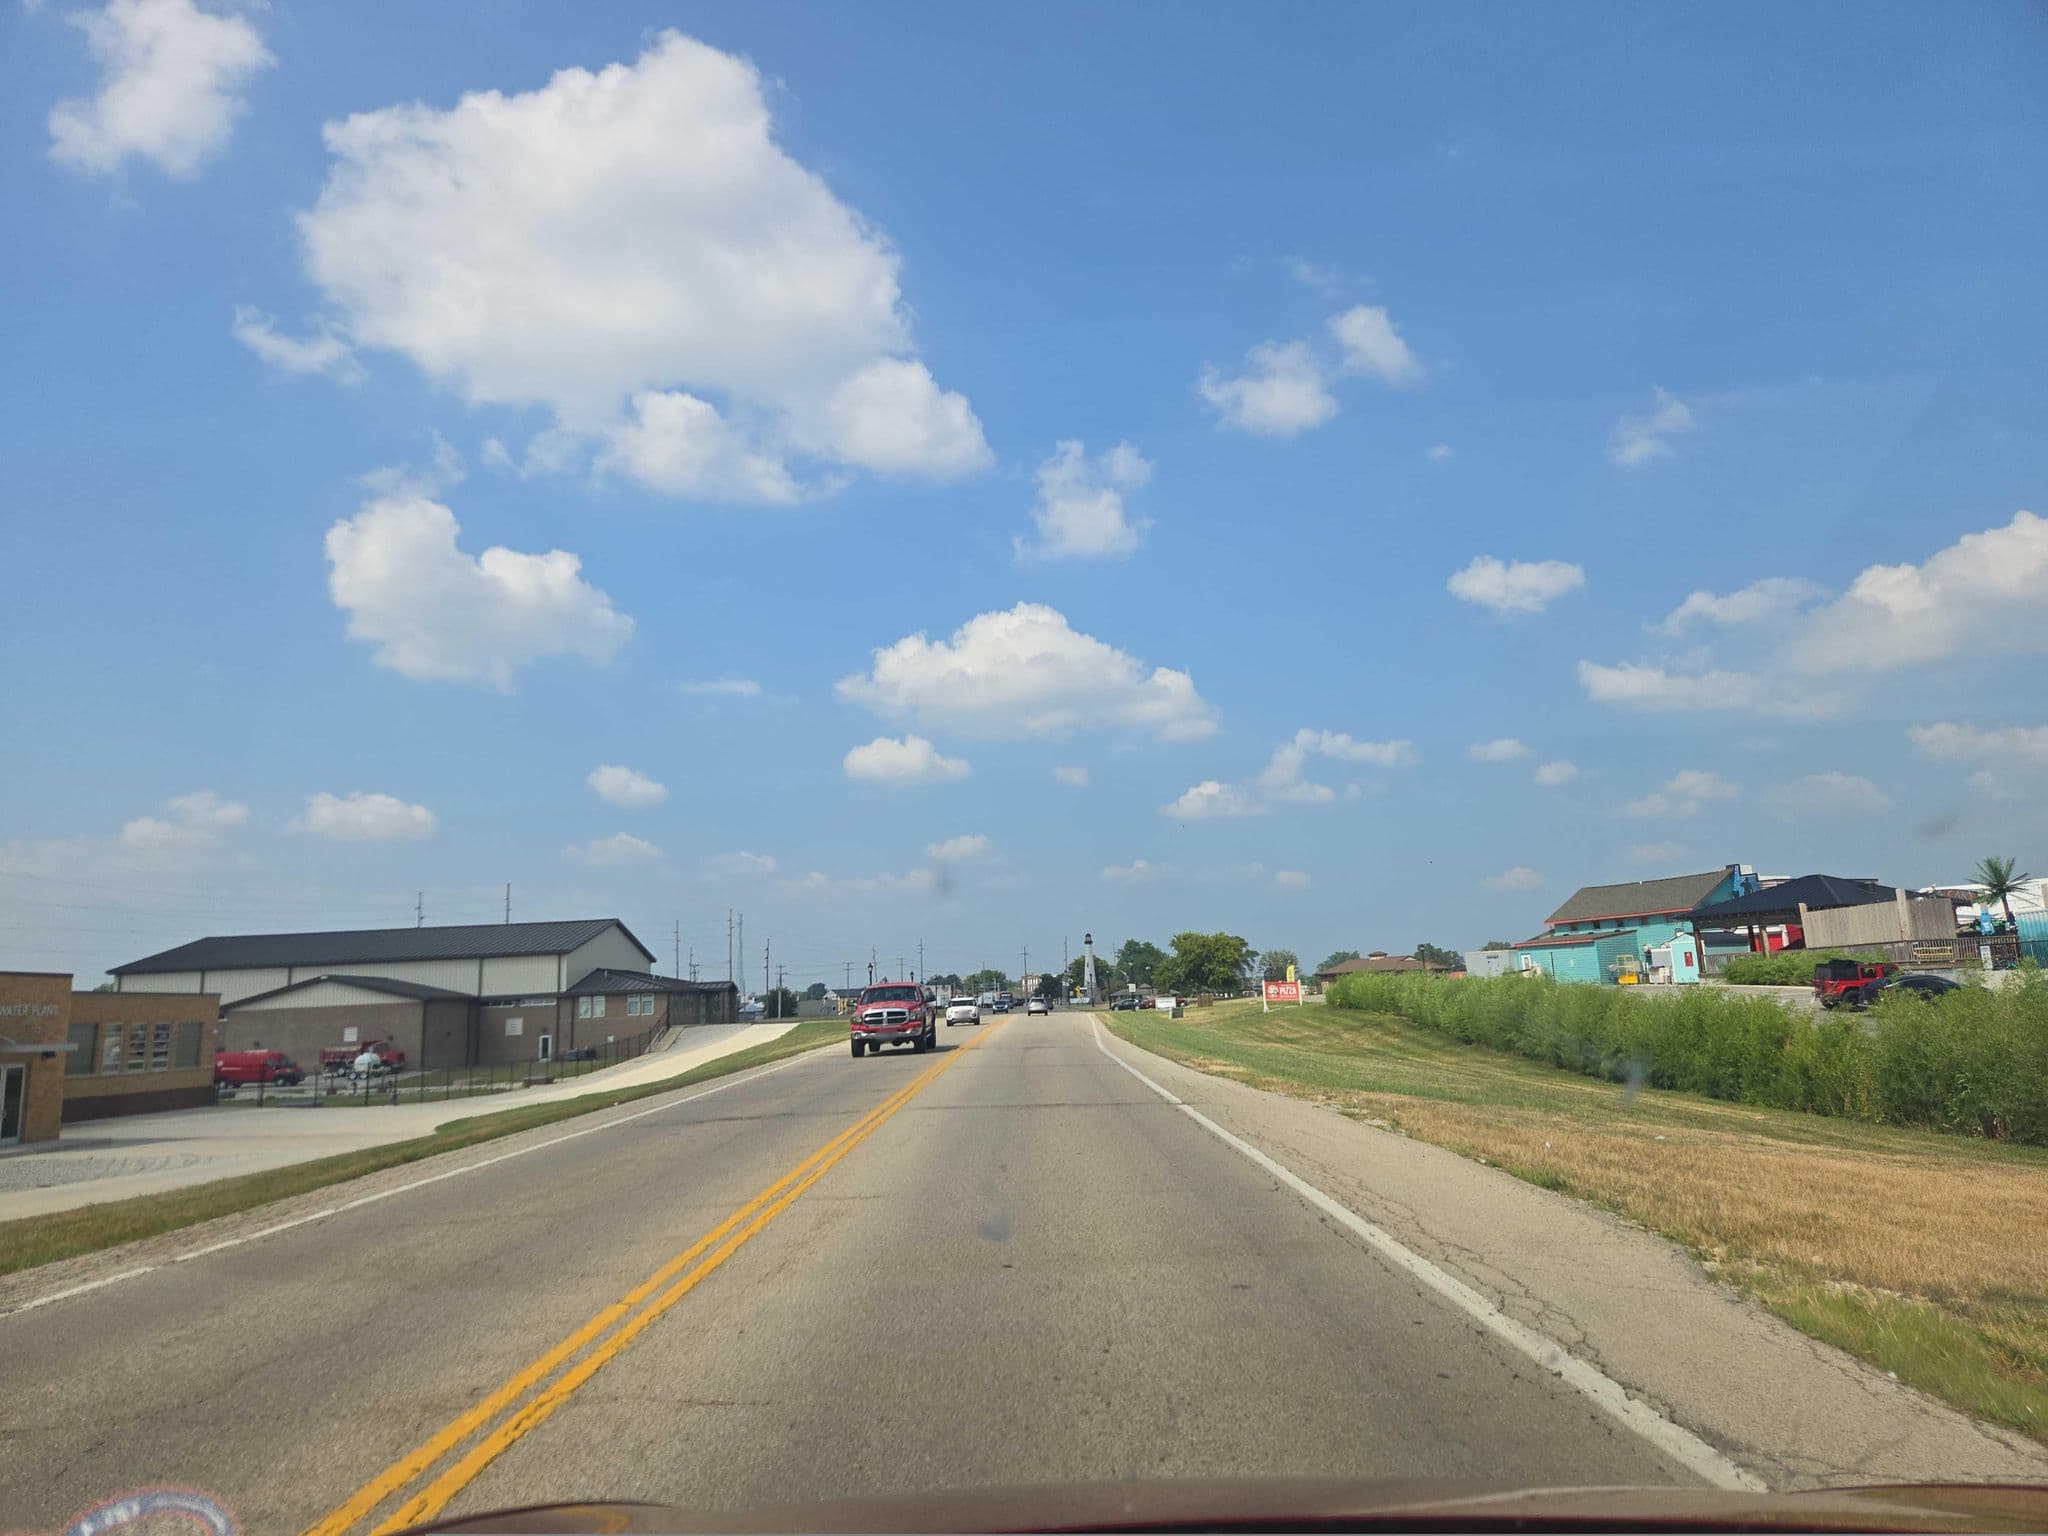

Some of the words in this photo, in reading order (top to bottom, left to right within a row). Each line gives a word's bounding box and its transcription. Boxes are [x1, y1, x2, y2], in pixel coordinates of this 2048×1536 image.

[1279, 986, 1297, 995] PIZZA
[0, 1004, 28, 1016] WATER
[32, 1004, 58, 1016] PLANT
